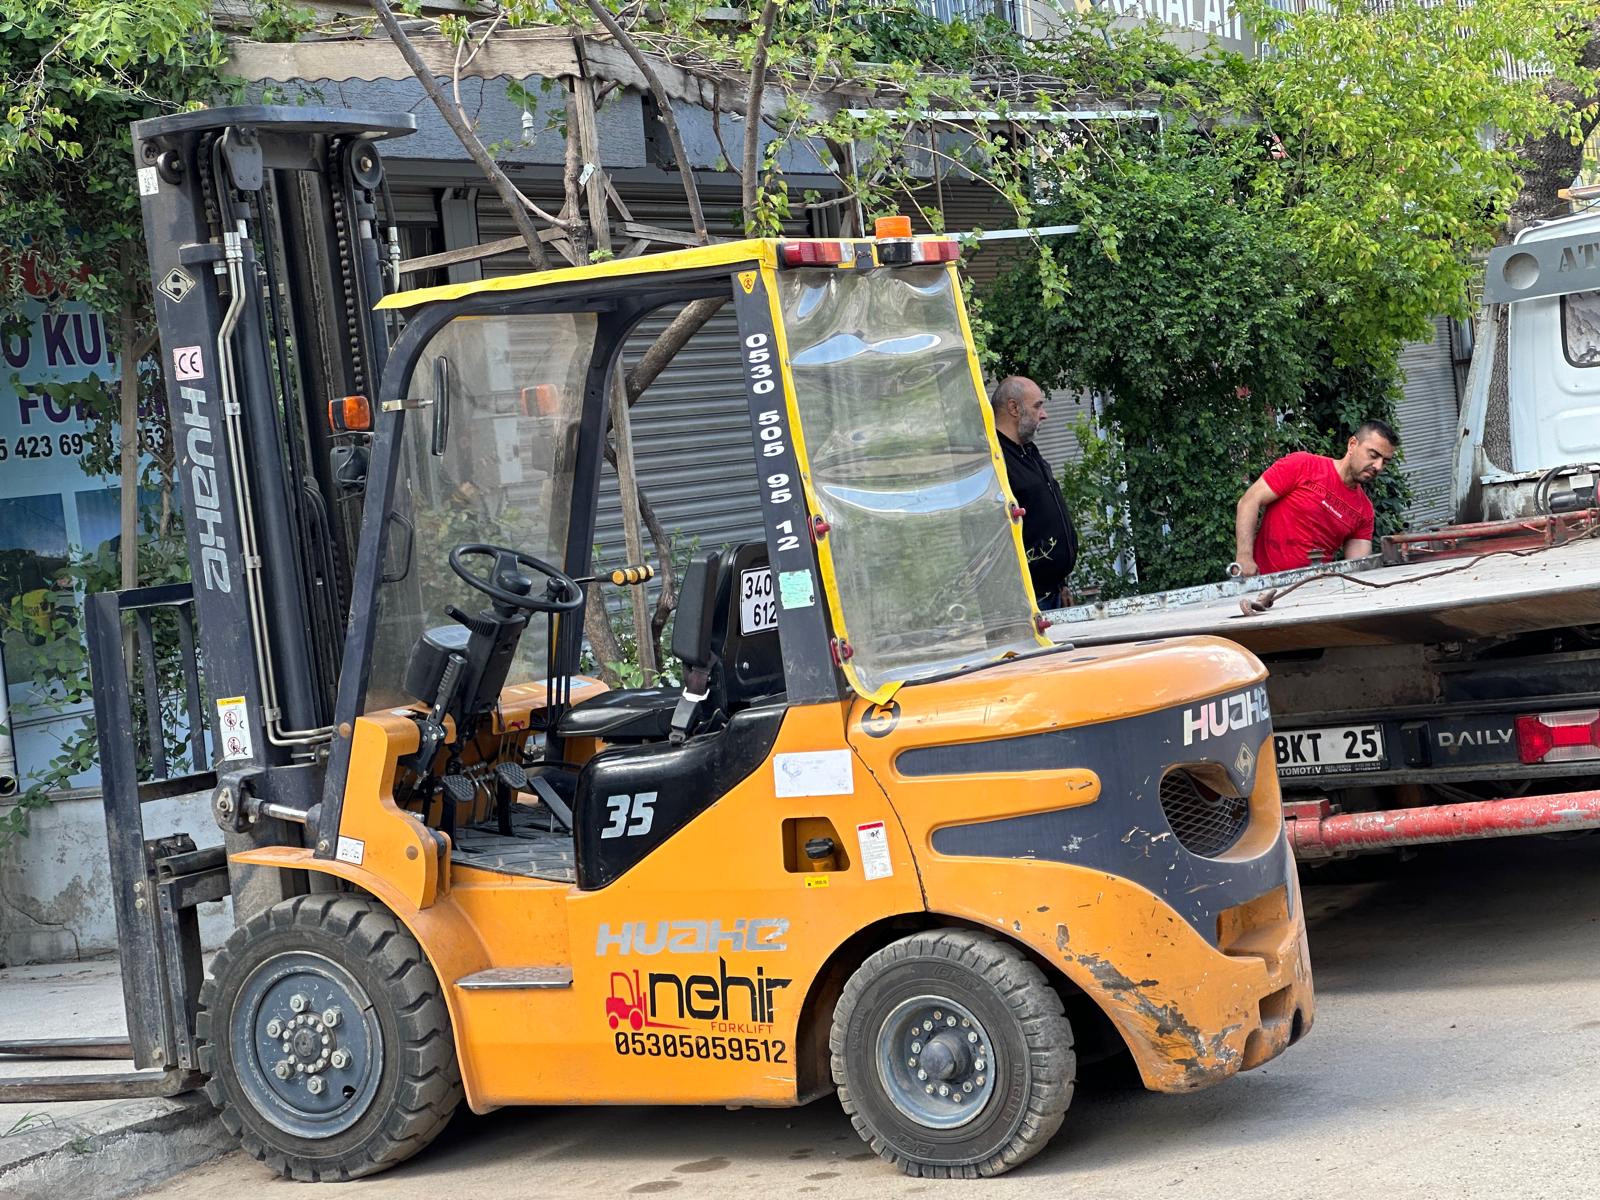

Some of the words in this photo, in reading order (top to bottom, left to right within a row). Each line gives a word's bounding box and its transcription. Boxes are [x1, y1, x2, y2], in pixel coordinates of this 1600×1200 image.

[178, 351, 201, 375] CE
[745, 332, 775, 395] 0530
[14, 435, 53, 459] 423
[59, 433, 83, 456] 69
[758, 409, 785, 457] 505
[767, 473, 792, 504] 95
[776, 520, 800, 551] 12
[744, 573, 773, 600] 340
[753, 600, 777, 627] 612
[867, 700, 897, 734] 5
[1274, 732, 1322, 765] BKT
[1342, 729, 1378, 759] 25
[1437, 728, 1514, 747] DAILY
[1277, 765, 1322, 777] TOMOTİV
[600, 791, 658, 839] 35
[648, 955, 793, 1024] nehir
[614, 1031, 788, 1064] 05305059512
